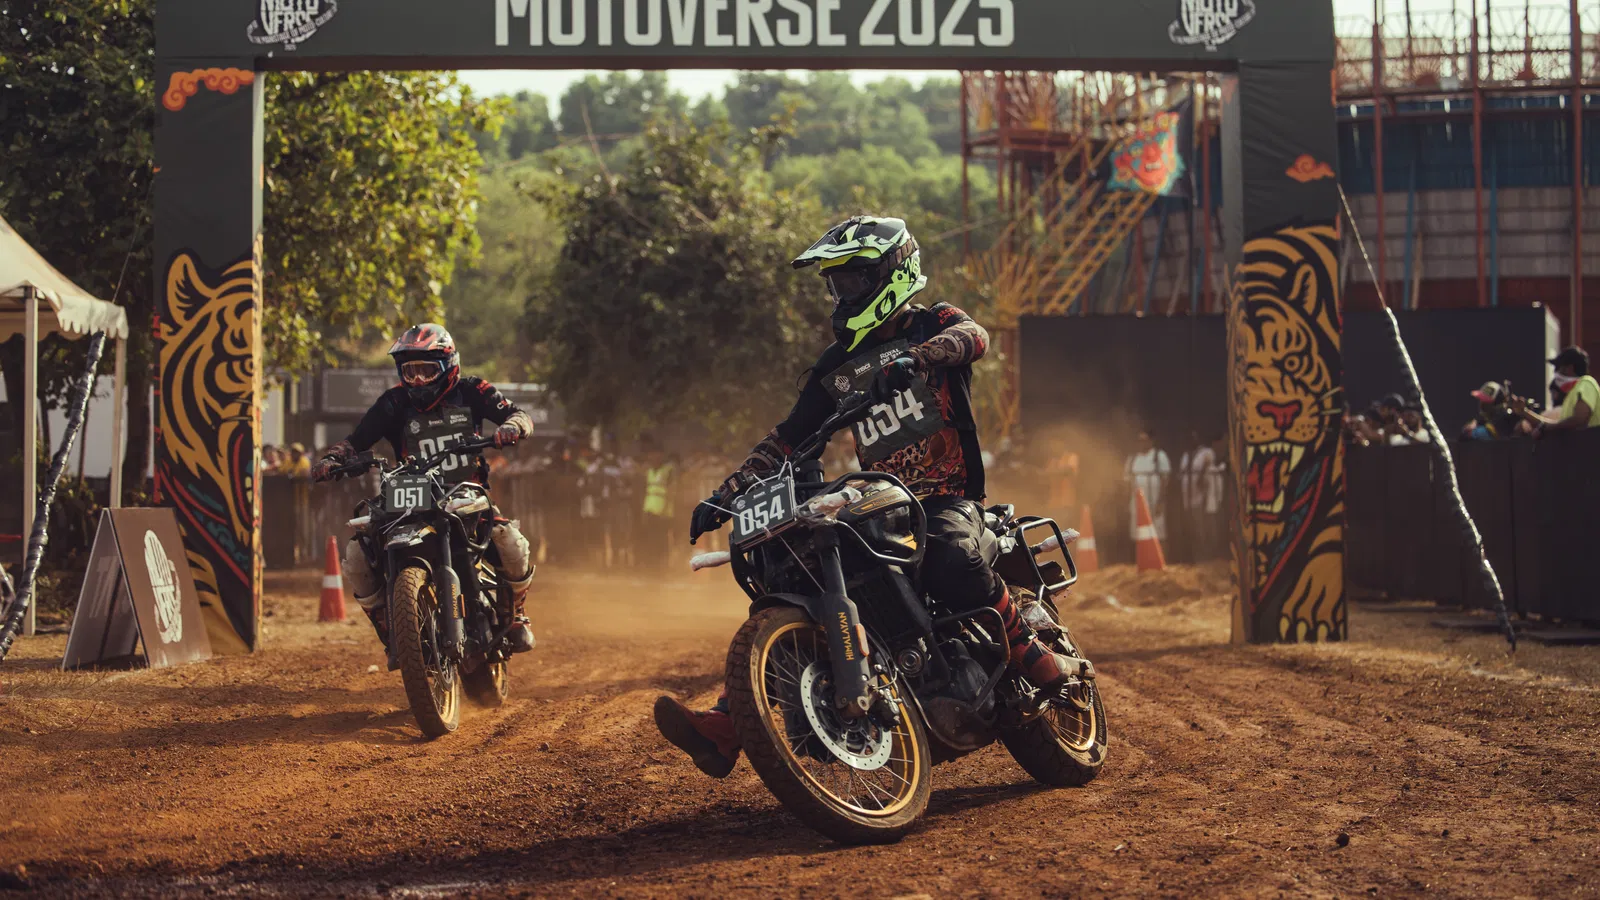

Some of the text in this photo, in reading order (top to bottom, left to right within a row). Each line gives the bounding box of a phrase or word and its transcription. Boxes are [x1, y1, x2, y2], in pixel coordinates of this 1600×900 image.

[495, 0, 1015, 46] MOTOVERSE 2025
[394, 487, 424, 508] 051
[739, 495, 785, 536] 054
[838, 612, 854, 660] HIMALAYAN
